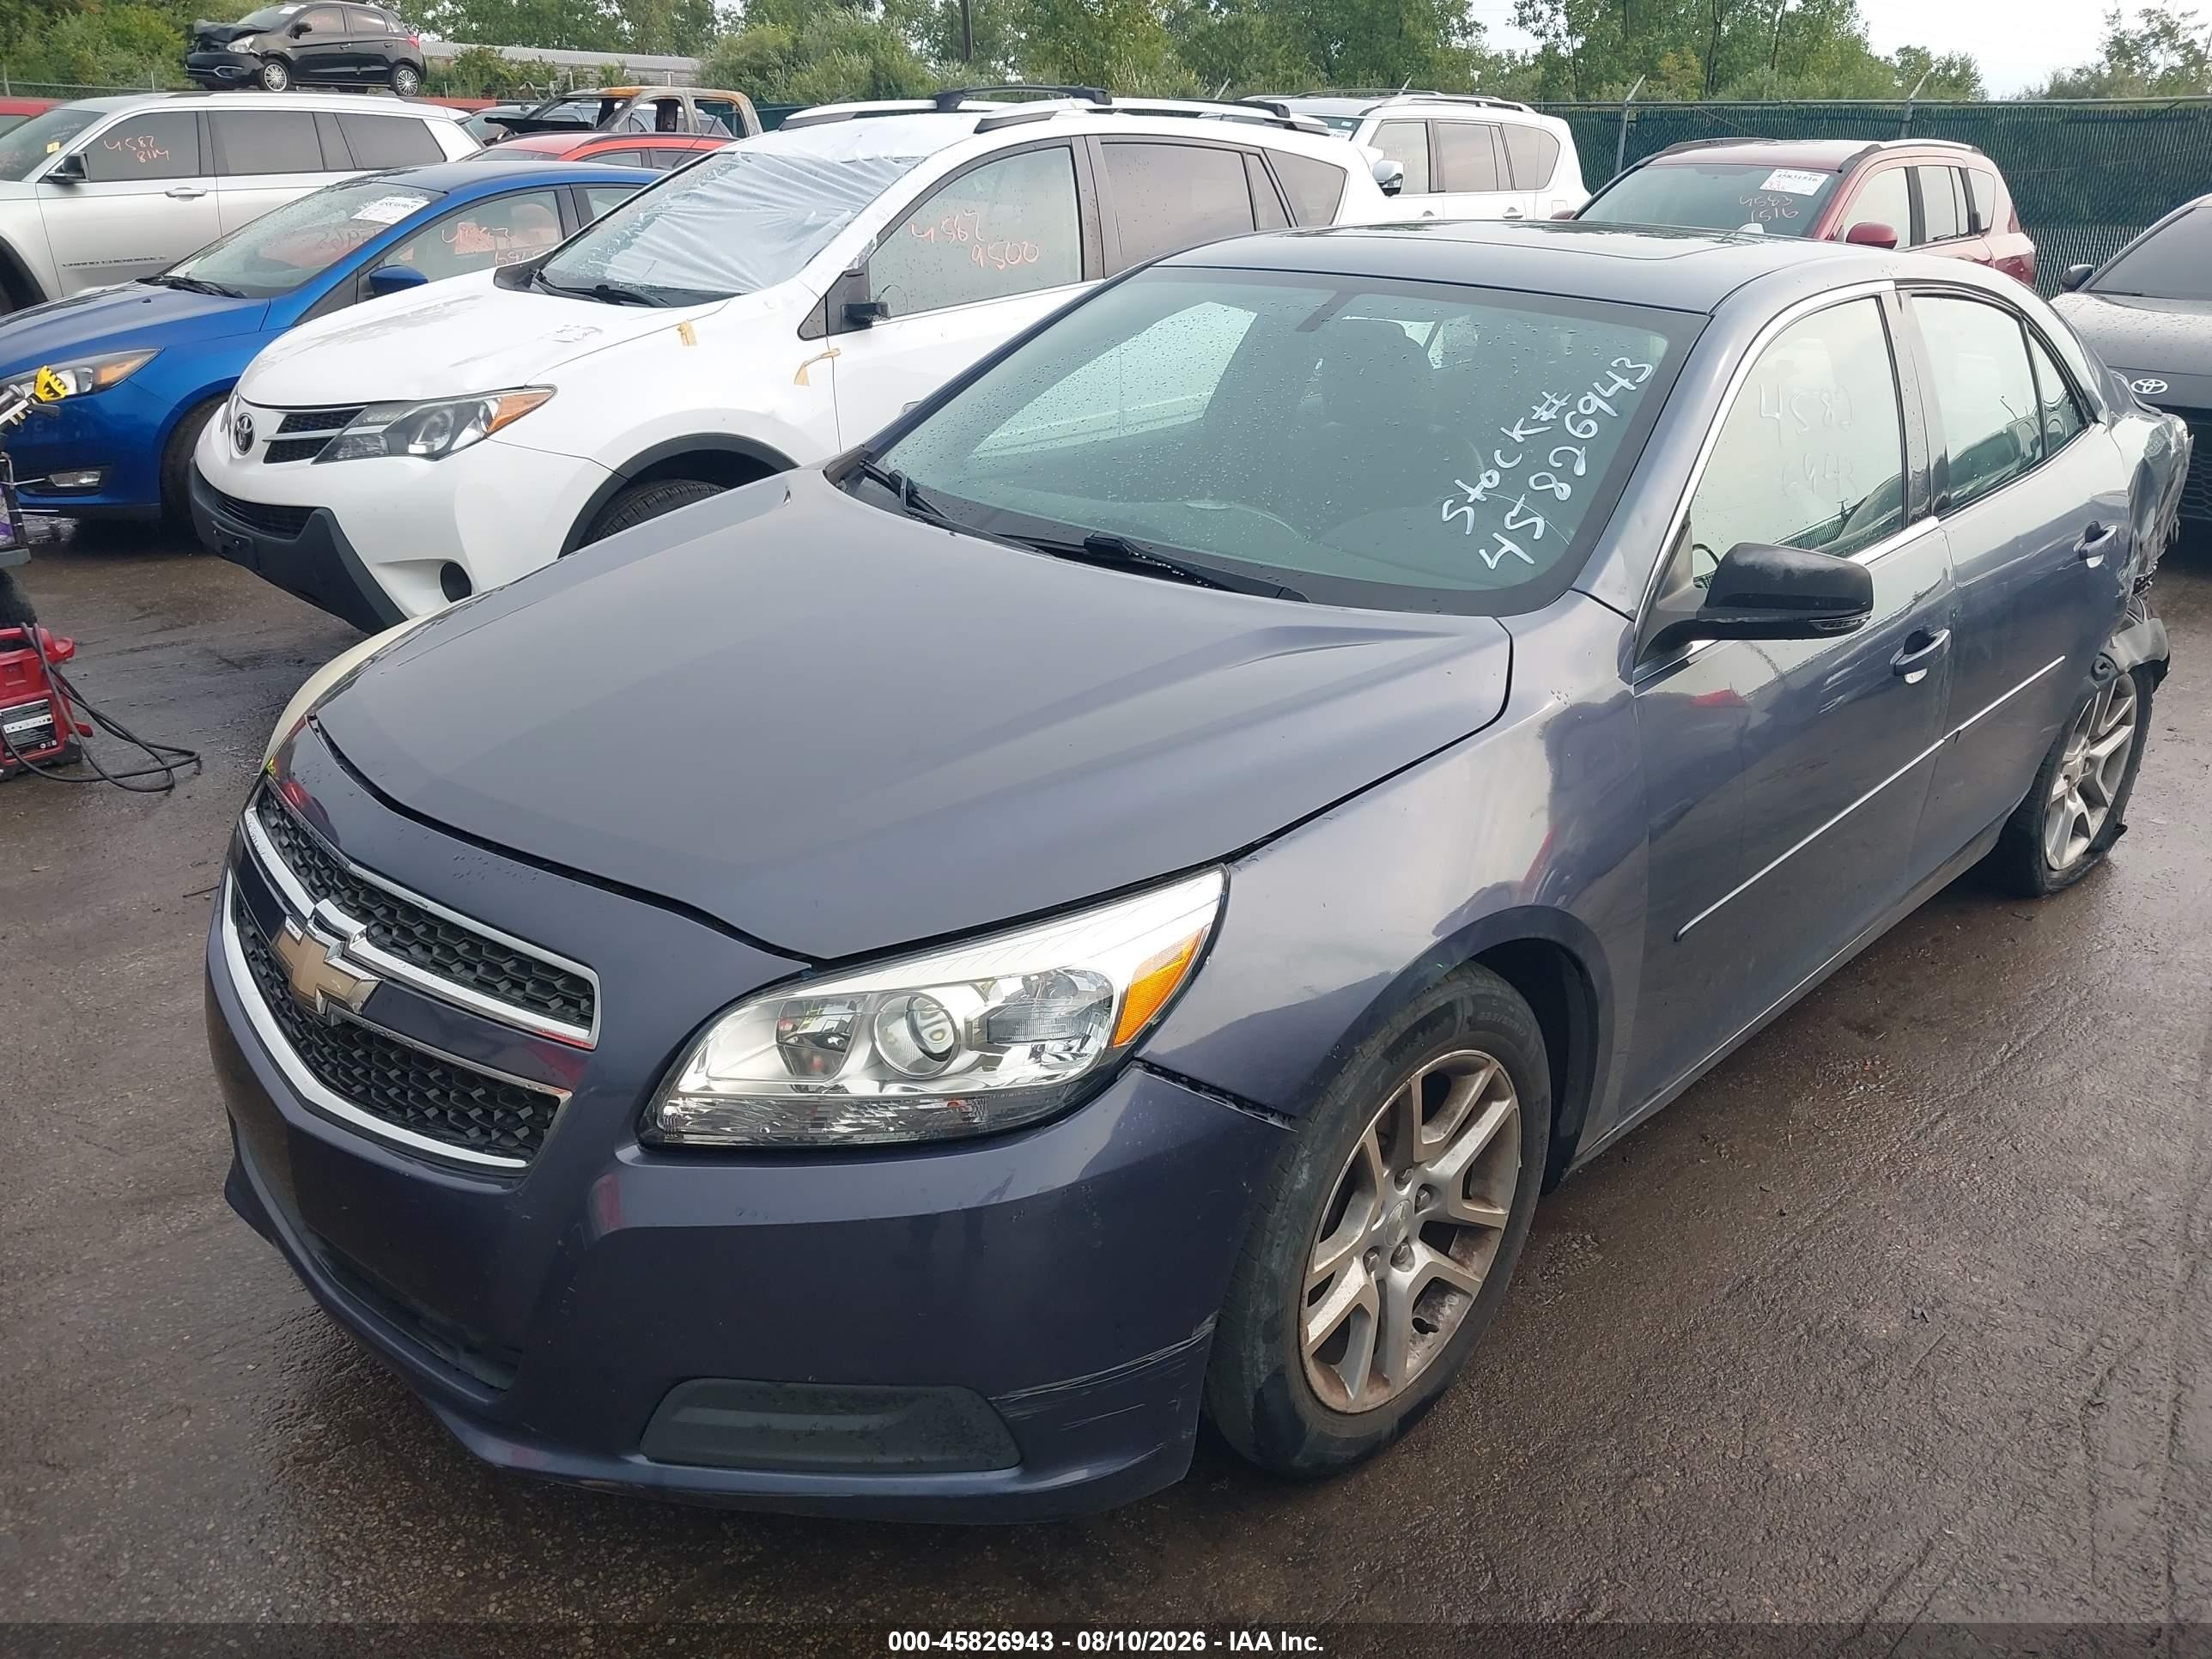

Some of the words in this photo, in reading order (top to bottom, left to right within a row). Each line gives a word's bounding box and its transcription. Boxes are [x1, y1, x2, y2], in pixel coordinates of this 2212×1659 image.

[1751, 207, 1799, 222] 1516
[971, 240, 1038, 270] 9500
[1479, 356, 1654, 570] 45826943
